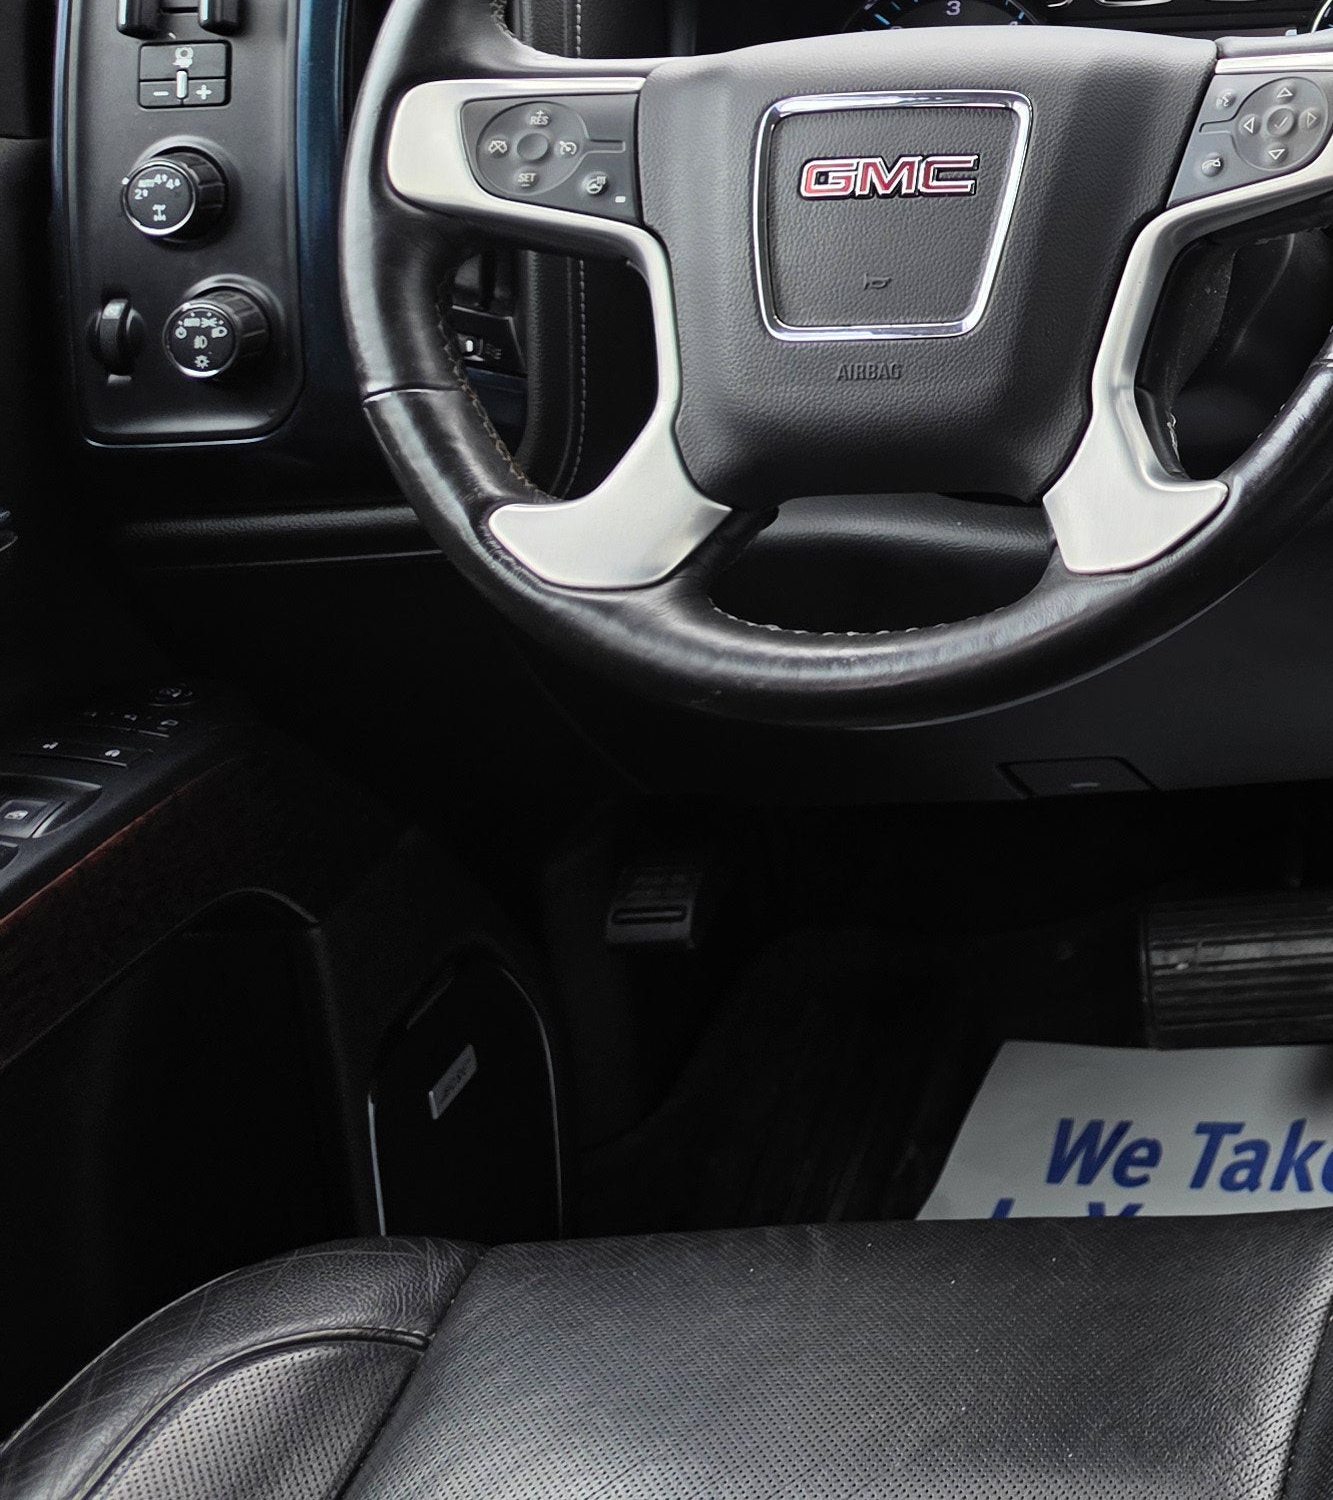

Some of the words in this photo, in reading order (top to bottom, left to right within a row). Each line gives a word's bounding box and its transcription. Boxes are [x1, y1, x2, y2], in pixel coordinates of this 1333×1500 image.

[947, 0, 961, 17] 3
[530, 116, 549, 125] RES
[518, 173, 536, 182] SET
[800, 154, 980, 201] GMC
[837, 363, 902, 382] AIRBAG
[1044, 1117, 1164, 1189] We
